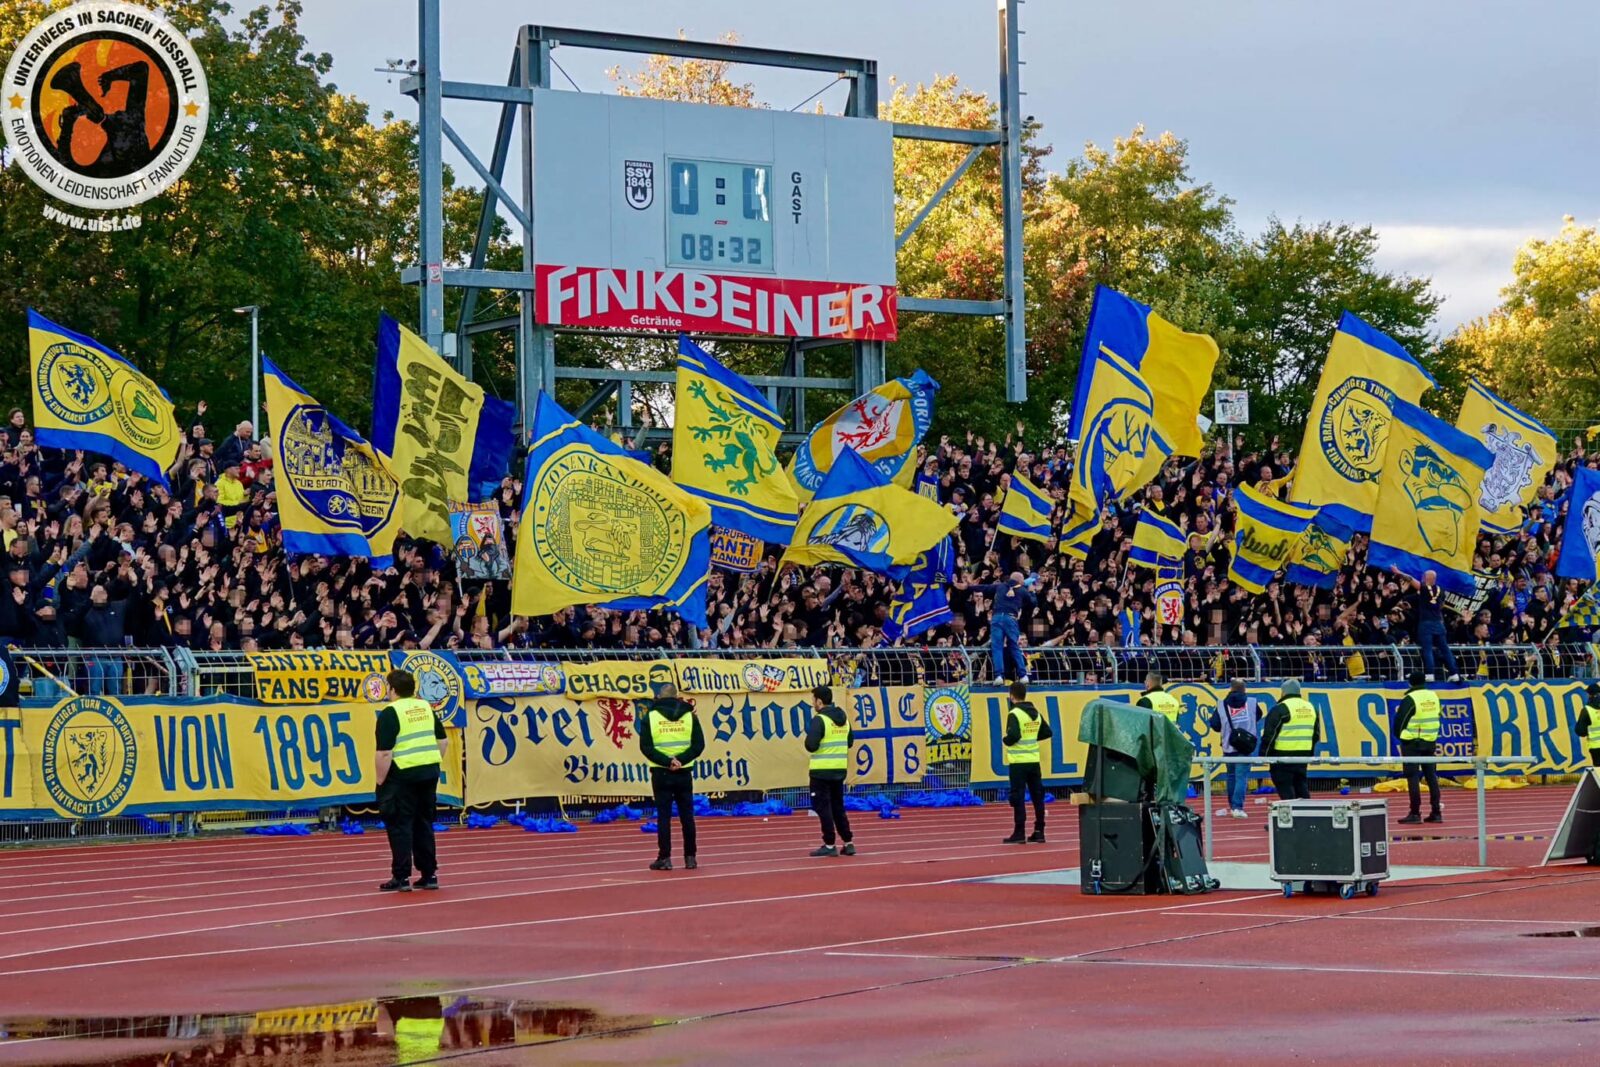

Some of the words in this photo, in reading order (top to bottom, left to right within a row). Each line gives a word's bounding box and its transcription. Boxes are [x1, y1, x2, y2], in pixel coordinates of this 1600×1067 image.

[626, 167, 652, 178] SSV
[626, 177, 652, 188] 1846
[791, 171, 802, 225] GAST
[547, 266, 885, 338] FINKBEINER
[631, 314, 682, 327] Getränke
[536, 523, 584, 588] ULTRAS
[651, 543, 682, 585] 2005
[713, 536, 754, 557] ANTI
[251, 654, 388, 672] EINTRACHT
[258, 678, 320, 699] FANS
[325, 677, 361, 698] BW
[493, 678, 537, 692] BOYS
[568, 673, 647, 694] CHAOS
[682, 666, 741, 692] Müden
[45, 703, 78, 782] BRAUNSCHWEIGER
[81, 699, 100, 710] TURN
[114, 715, 135, 776] SPORTVEREIN
[475, 697, 596, 767] Frei
[154, 713, 234, 791] VON
[254, 711, 362, 791] 1895
[856, 744, 873, 776] 9
[904, 742, 920, 774] 8
[926, 742, 972, 763] HARZ
[563, 751, 750, 786] Braunweig
[51, 784, 93, 814] EINTRACHT
